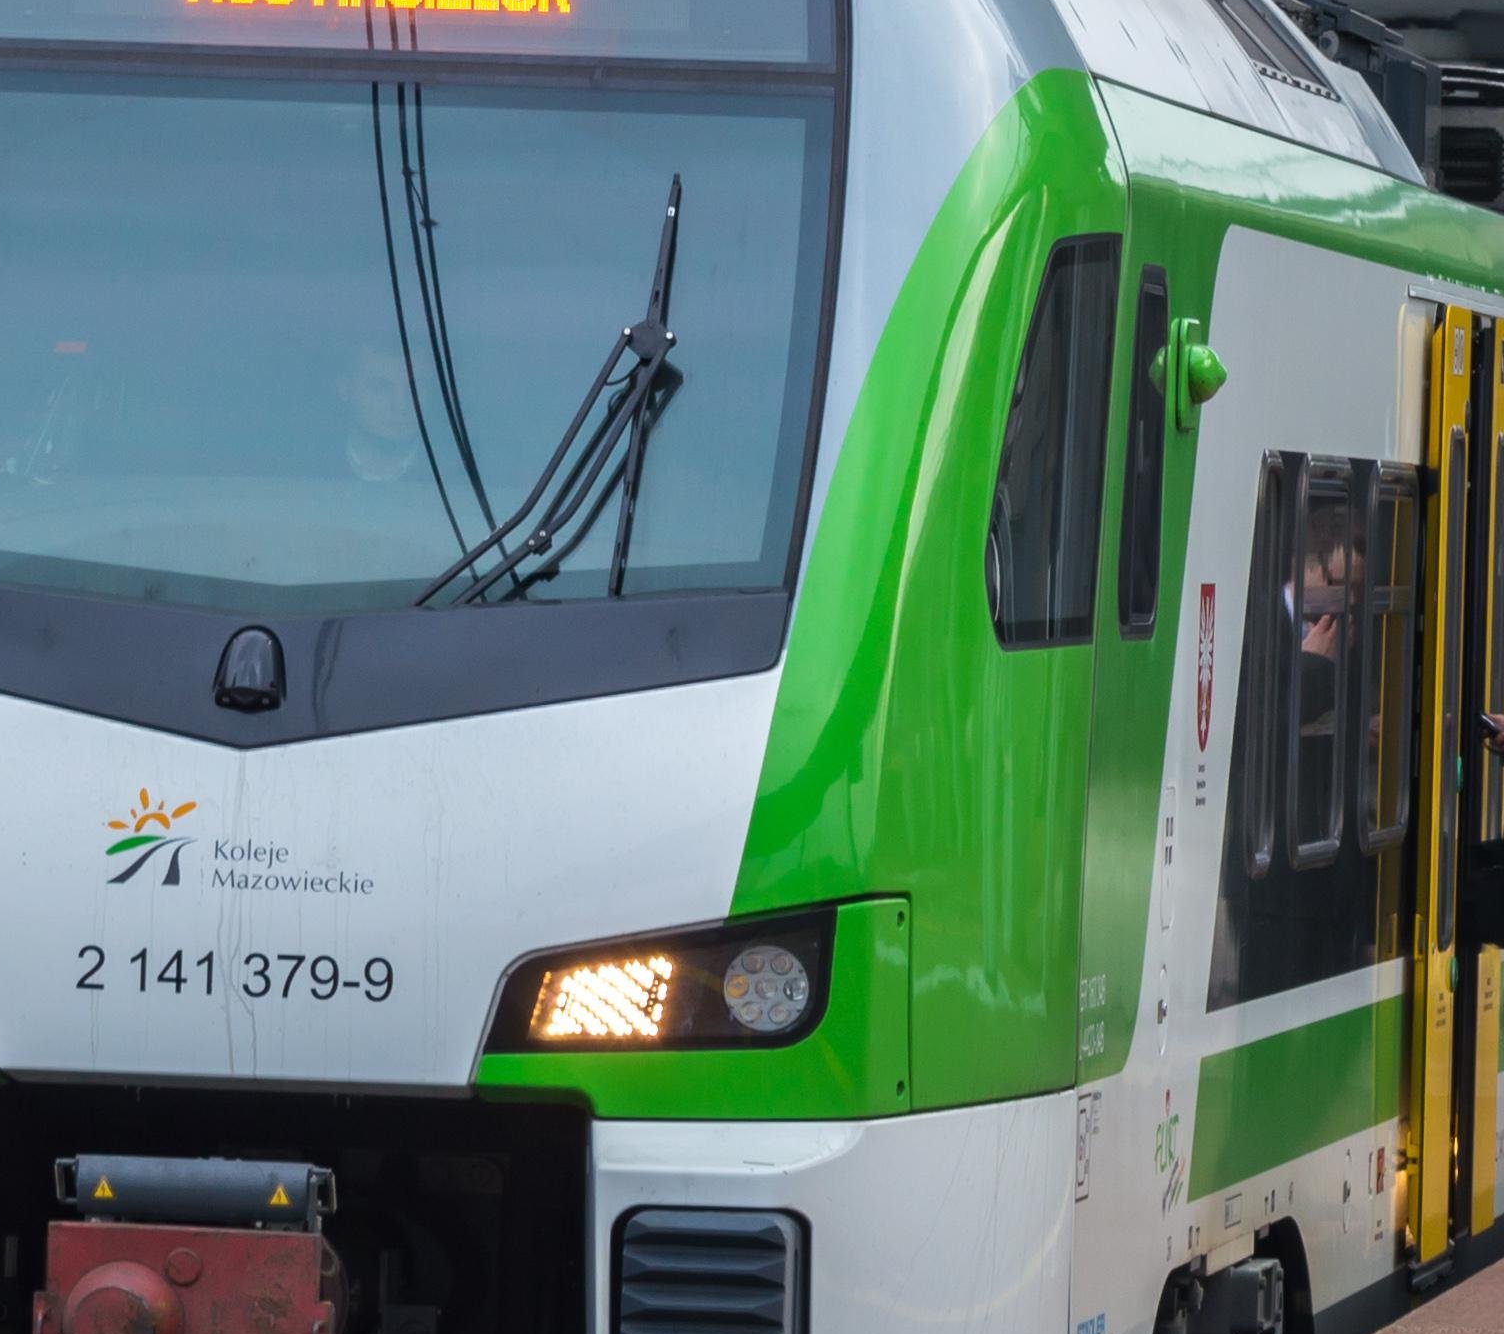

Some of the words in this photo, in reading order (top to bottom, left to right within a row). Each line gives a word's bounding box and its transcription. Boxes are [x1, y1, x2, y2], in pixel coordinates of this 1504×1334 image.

[213, 838, 290, 869] Koleje
[211, 868, 375, 895] Mazowieckie
[75, 944, 106, 990] 2
[129, 946, 215, 996] 141
[242, 952, 395, 1003] 379-9
